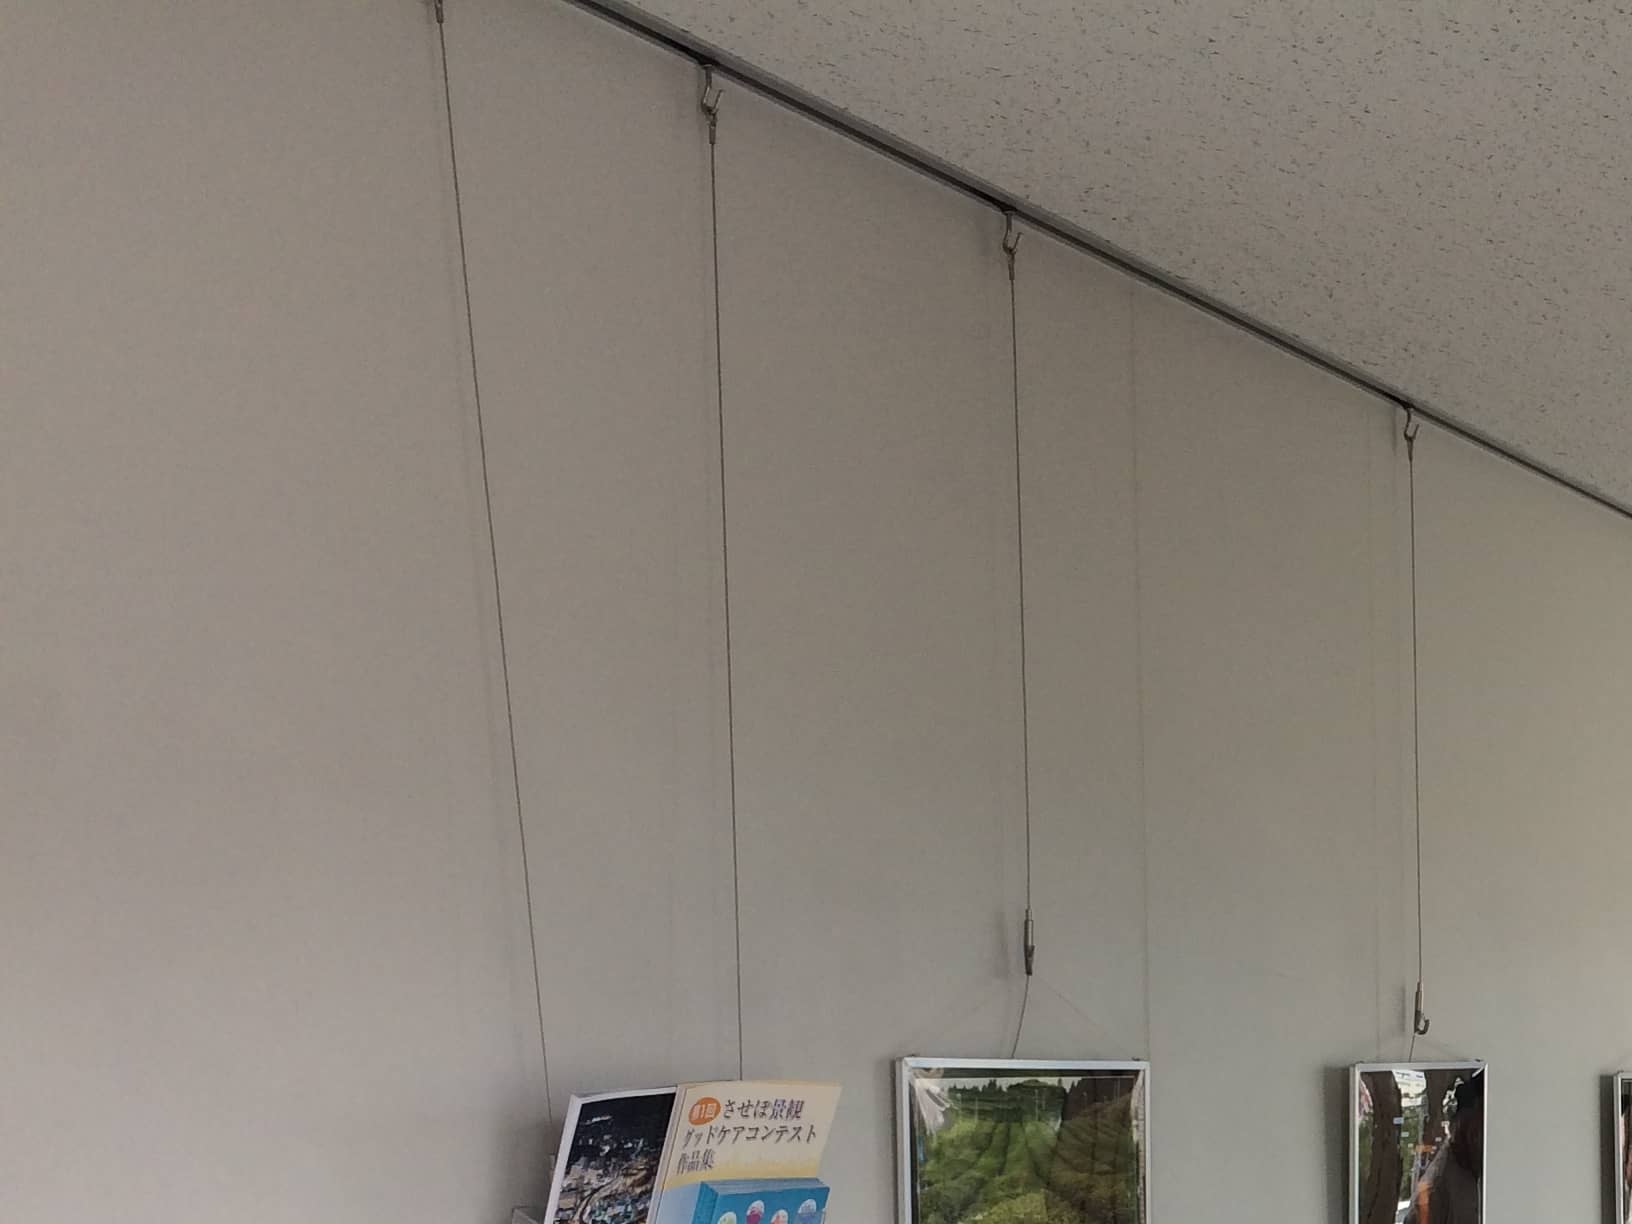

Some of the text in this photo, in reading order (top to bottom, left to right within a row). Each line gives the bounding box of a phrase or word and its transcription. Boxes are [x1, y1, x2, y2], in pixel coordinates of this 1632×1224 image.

[723, 1099, 805, 1121] させぼ景観
[677, 1149, 714, 1174] 作品集
